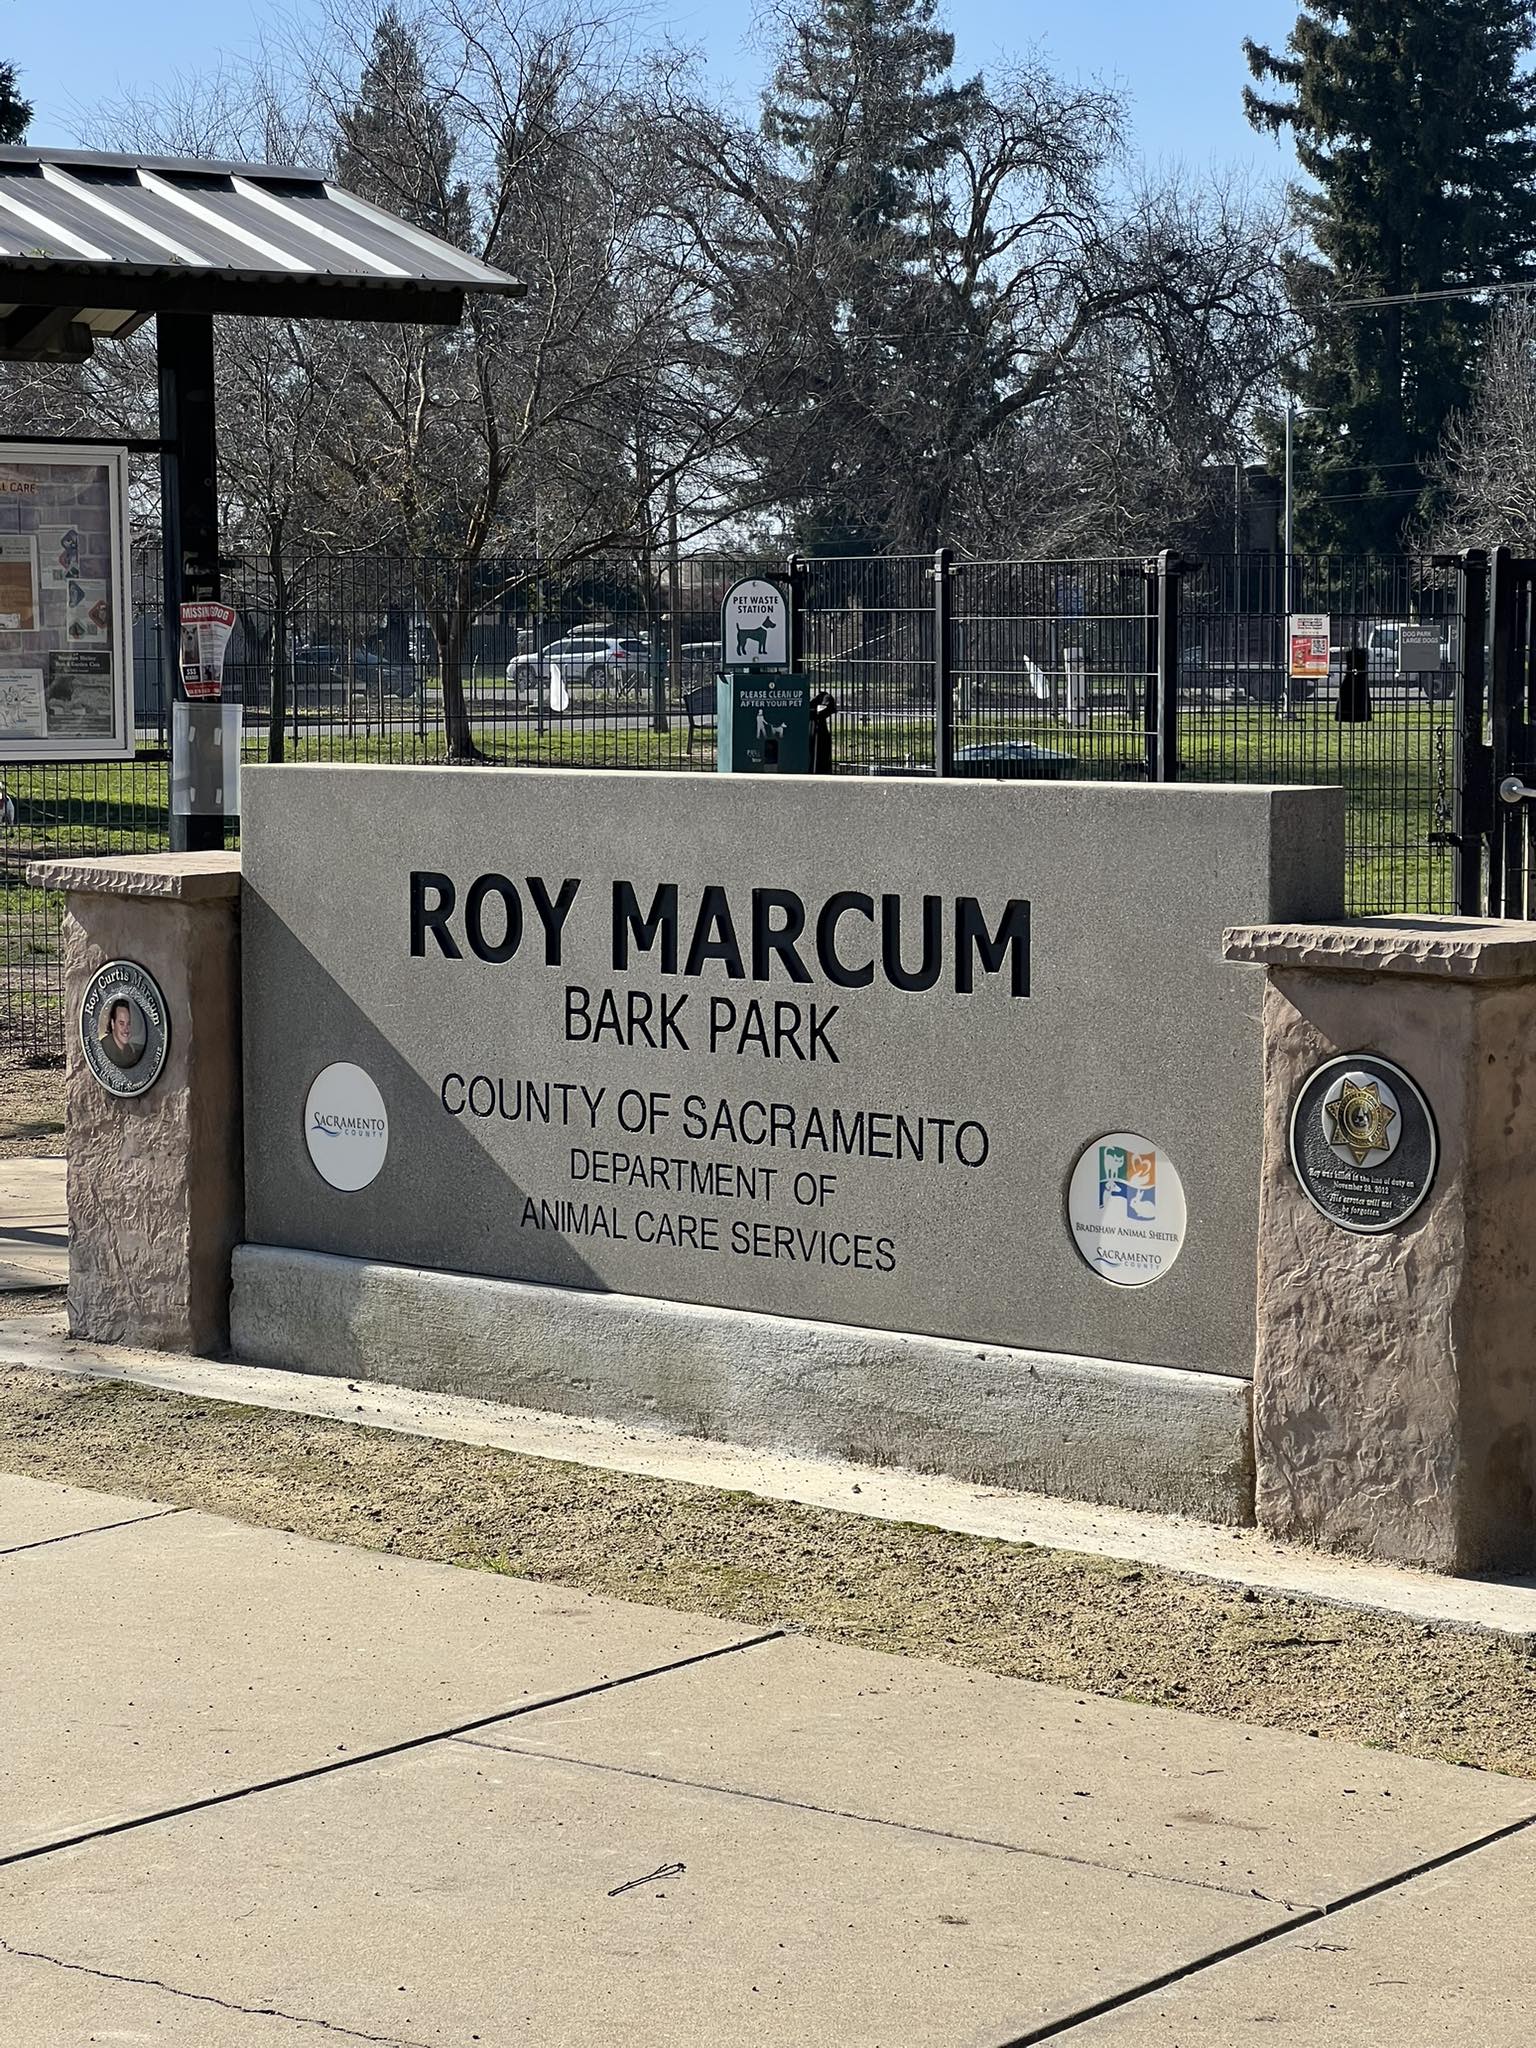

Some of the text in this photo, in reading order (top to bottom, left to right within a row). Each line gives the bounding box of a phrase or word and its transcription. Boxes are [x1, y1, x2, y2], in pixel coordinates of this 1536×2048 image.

[10, 482, 36, 494] CARE
[733, 596, 779, 605] PET WASTE
[738, 605, 774, 614] STATION
[740, 690, 767, 699] PLEASE
[410, 871, 1031, 998] ROY MARCUM
[84, 968, 161, 1027] Roy Curtis Marcum
[565, 986, 841, 1063] BARK PARK
[314, 1112, 384, 1130] SACRAMENTO
[441, 1073, 990, 1168] COUNTY OF SACRAMENTO
[344, 1129, 383, 1138] COUNTY
[571, 1148, 838, 1208] DEPARTMENT OF
[1334, 1171, 1351, 1180] killed
[1371, 1176, 1382, 1184] line
[1391, 1179, 1406, 1188] duty
[1334, 1181, 1363, 1191] November
[1374, 1186, 1389, 1194] 2012
[1343, 1195, 1365, 1205] service
[1366, 1198, 1380, 1207] will
[1381, 1200, 1392, 1208] not
[520, 1197, 897, 1272] ANIMAL CARE SERVICES
[1076, 1222, 1179, 1242] BRADSHAW ANIMAL SHELTER
[1096, 1246, 1162, 1264] SACRAMENTO
